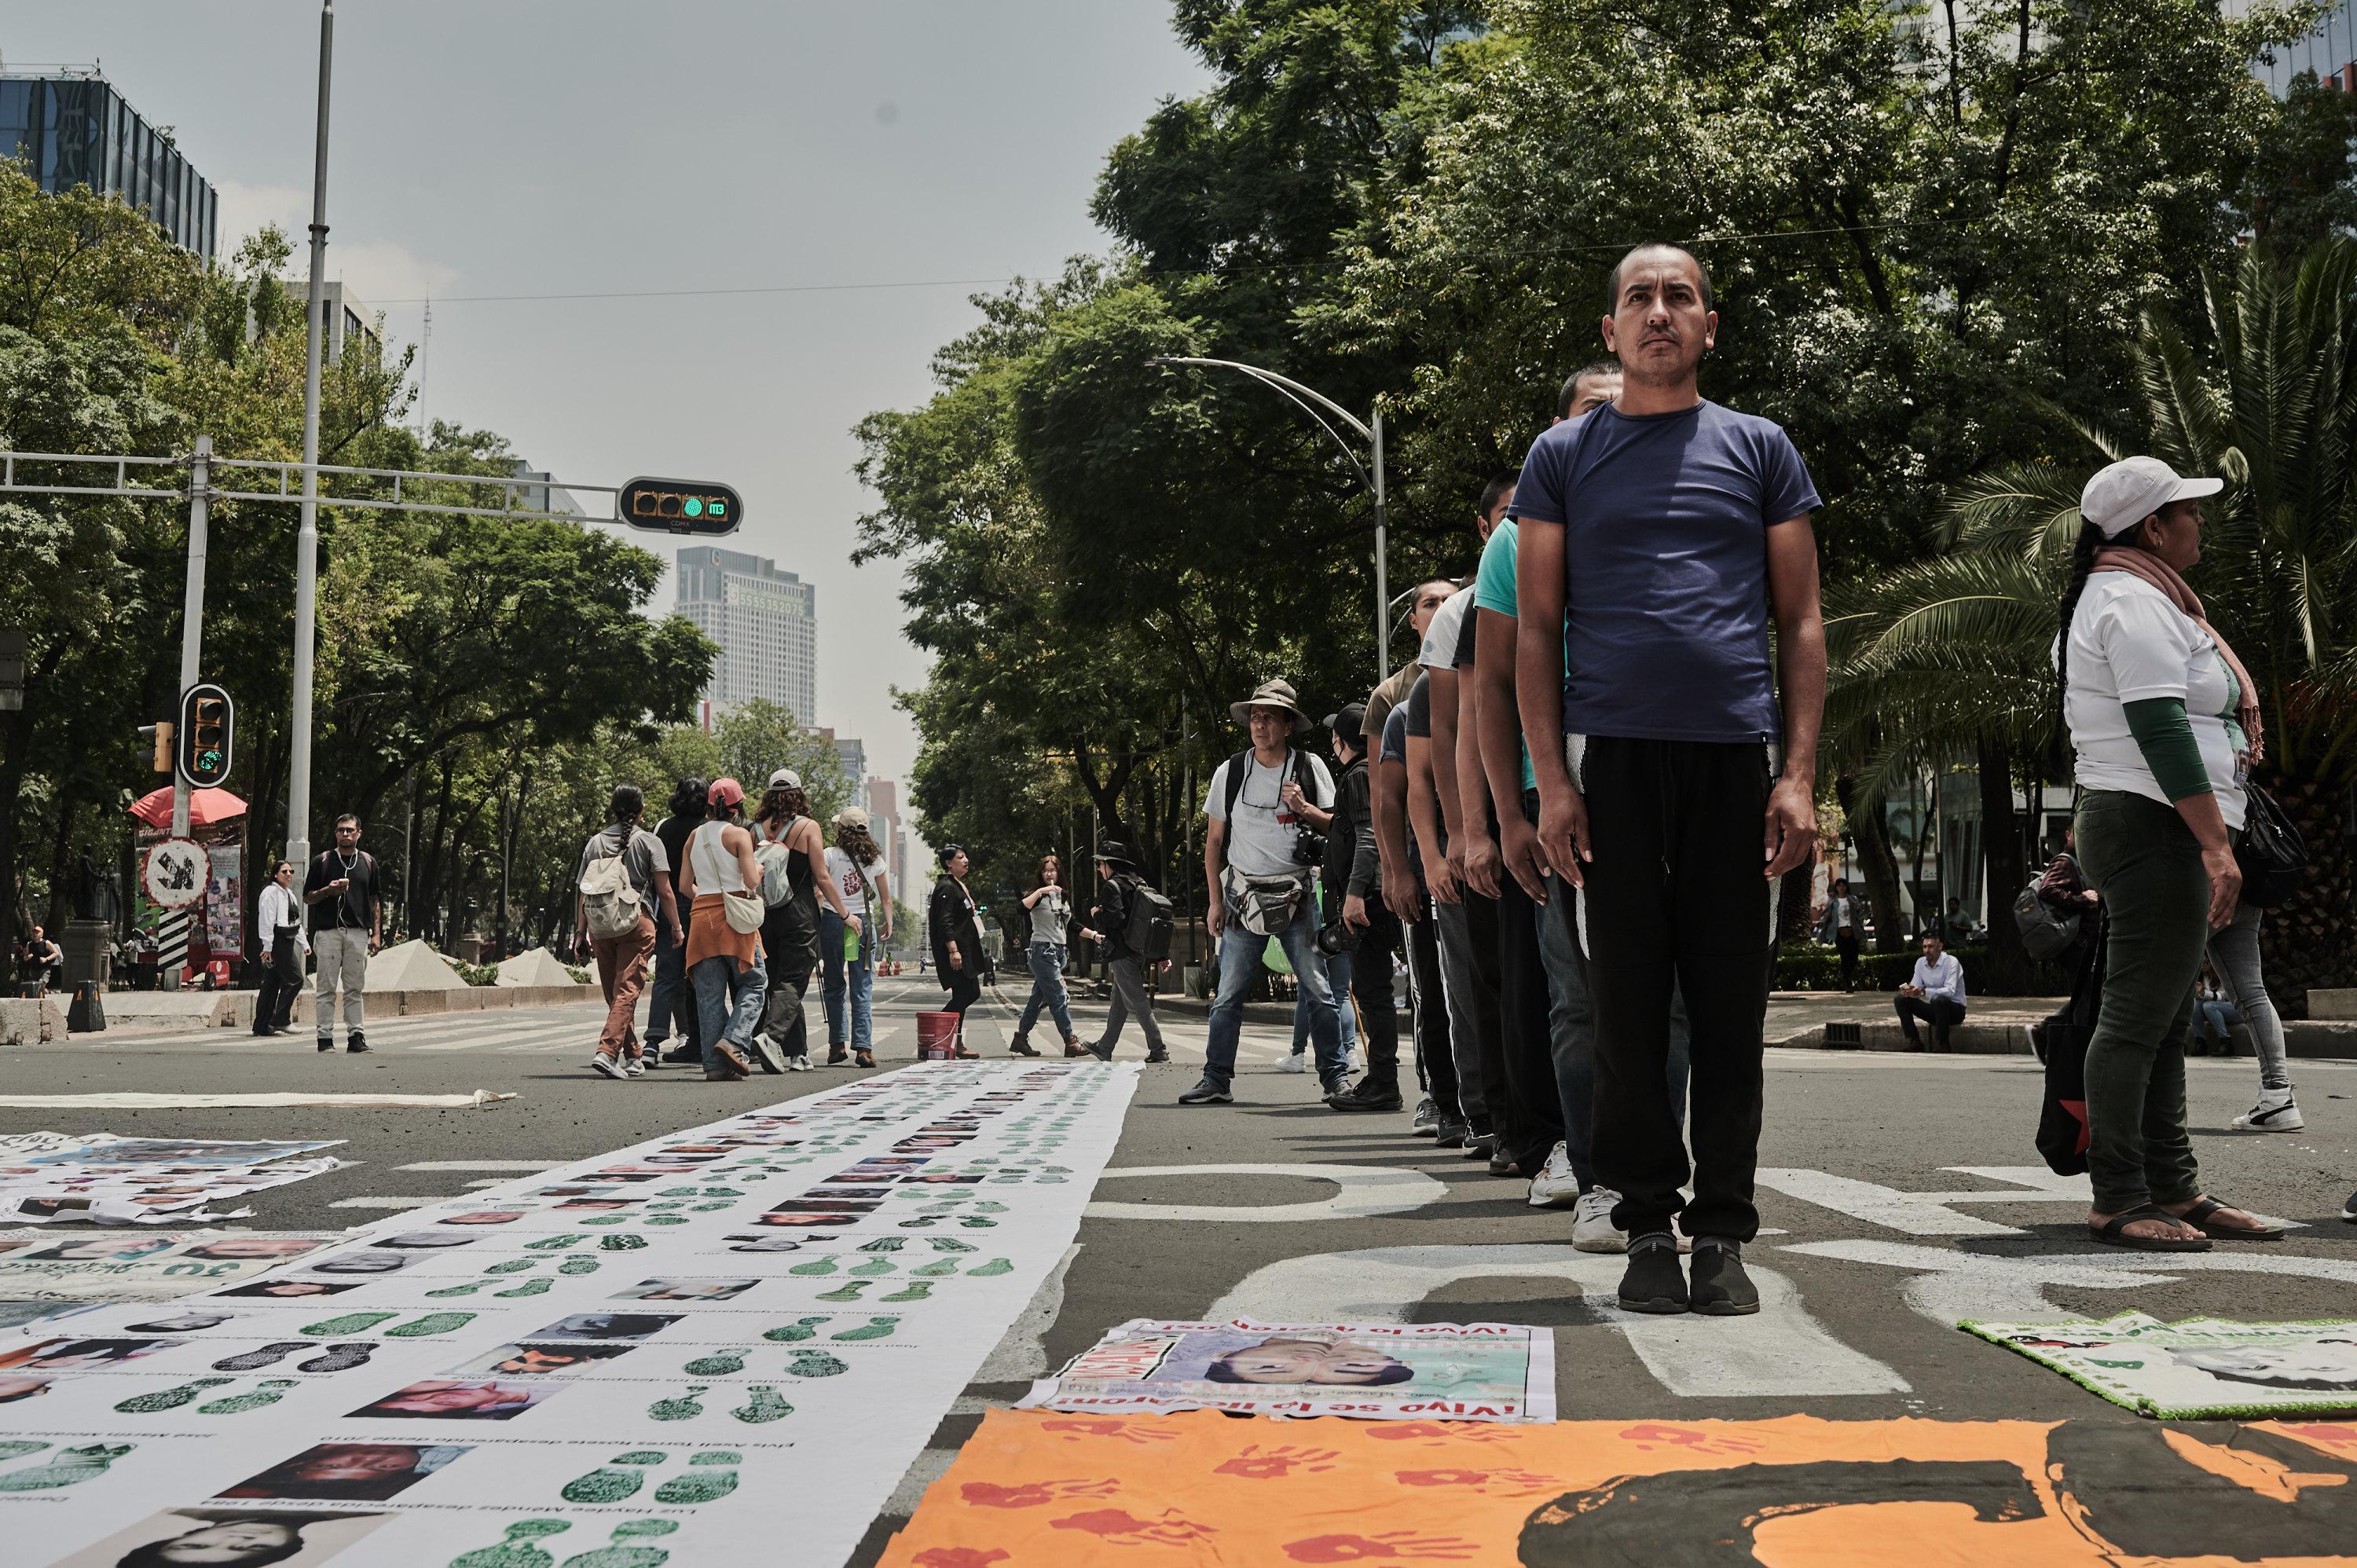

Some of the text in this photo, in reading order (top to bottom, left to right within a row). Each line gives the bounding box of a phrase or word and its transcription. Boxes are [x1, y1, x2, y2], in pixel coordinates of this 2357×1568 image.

[1272, 1401, 1311, 1412] lo
[1399, 1401, 1516, 1416] ¡Vivo
[330, 1502, 471, 1511] desaparecida
